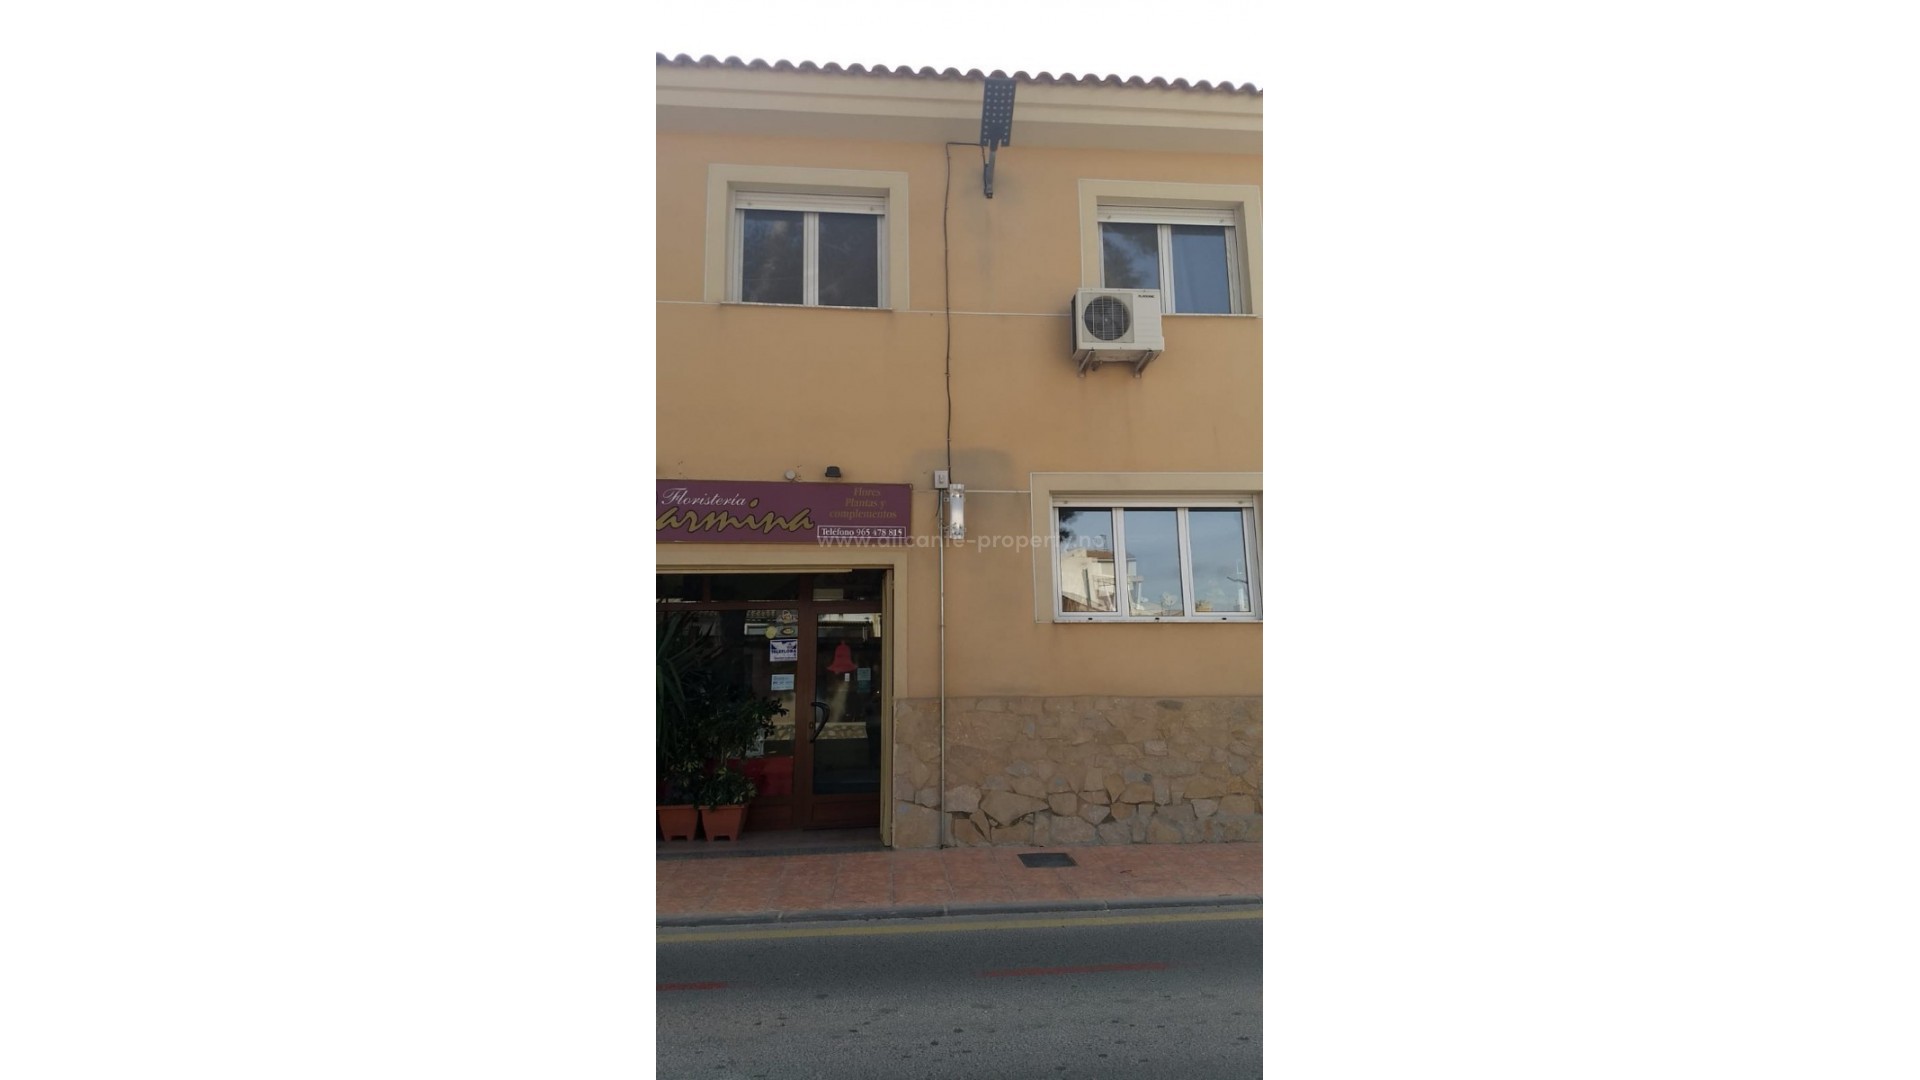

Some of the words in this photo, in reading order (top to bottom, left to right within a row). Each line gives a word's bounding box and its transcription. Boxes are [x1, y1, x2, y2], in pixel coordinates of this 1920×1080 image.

[661, 487, 746, 506] Floristería
[854, 487, 881, 497] Flores
[845, 498, 878, 508] Plantas
[656, 498, 815, 534] armina
[828, 510, 897, 520] complementos
[822, 527, 855, 536] Teléfono
[856, 528, 870, 536] 965
[872, 528, 887, 536] 478
[888, 528, 903, 536] 815
